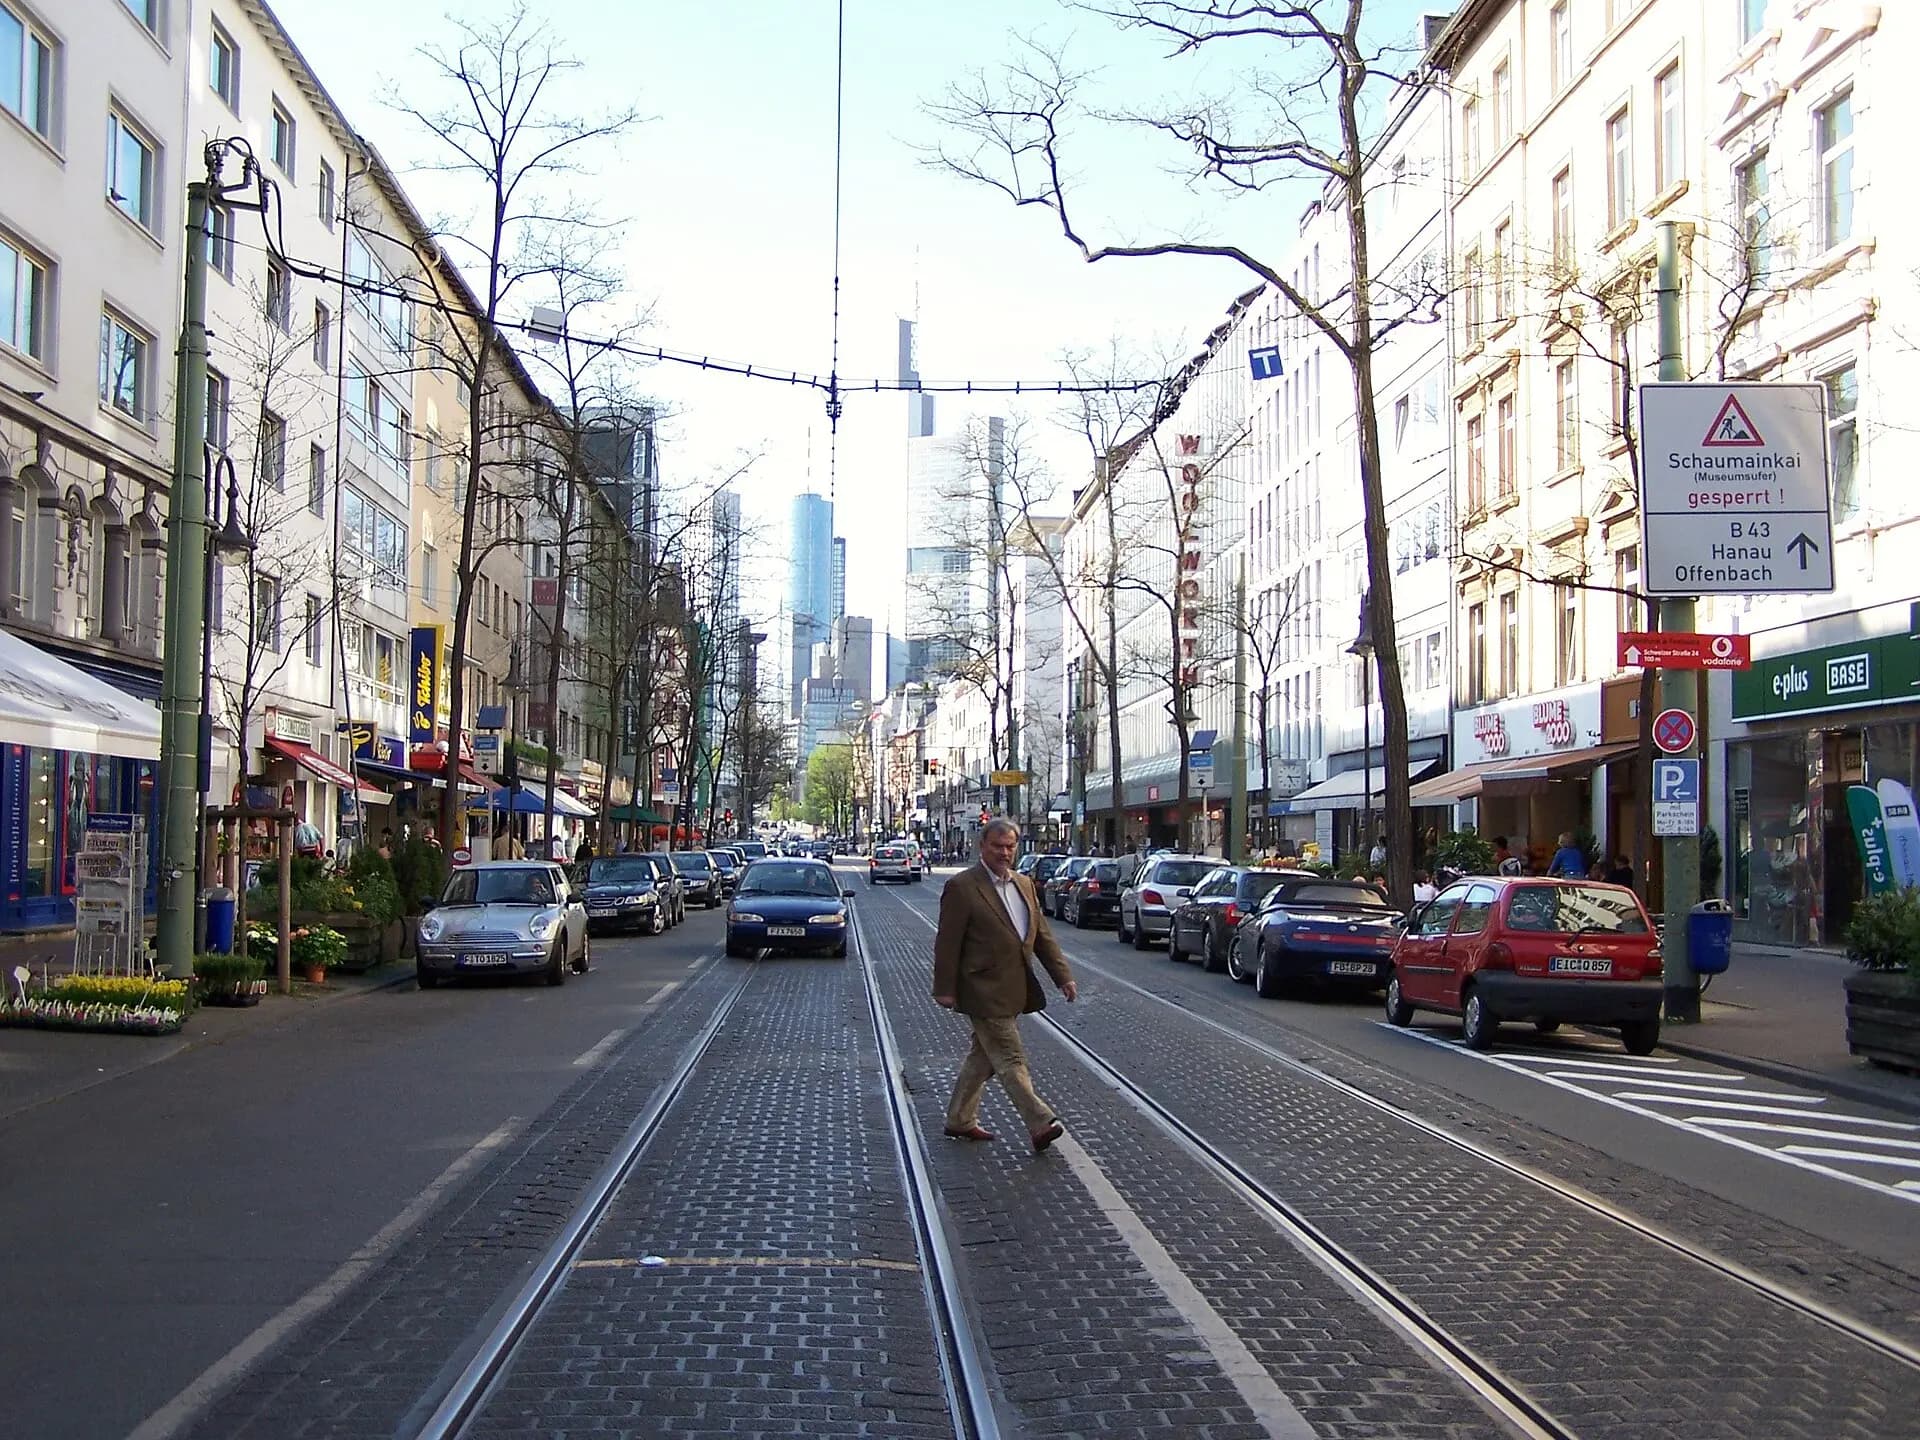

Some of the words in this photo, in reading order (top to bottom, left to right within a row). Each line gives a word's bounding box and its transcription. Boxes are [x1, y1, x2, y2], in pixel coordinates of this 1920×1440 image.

[1668, 452, 1801, 469] Schaumainkai
[1694, 471, 1777, 484] (Museumsufer)
[1688, 489, 1770, 508] gesperrt
[1730, 522, 1743, 538] B
[1748, 521, 1770, 538] 43
[1712, 543, 1771, 559] Hanau
[1675, 564, 1772, 581] Offenbach
[1702, 657, 1742, 665] vodafone
[1831, 661, 1864, 687] BASE
[1660, 765, 1685, 799] P
